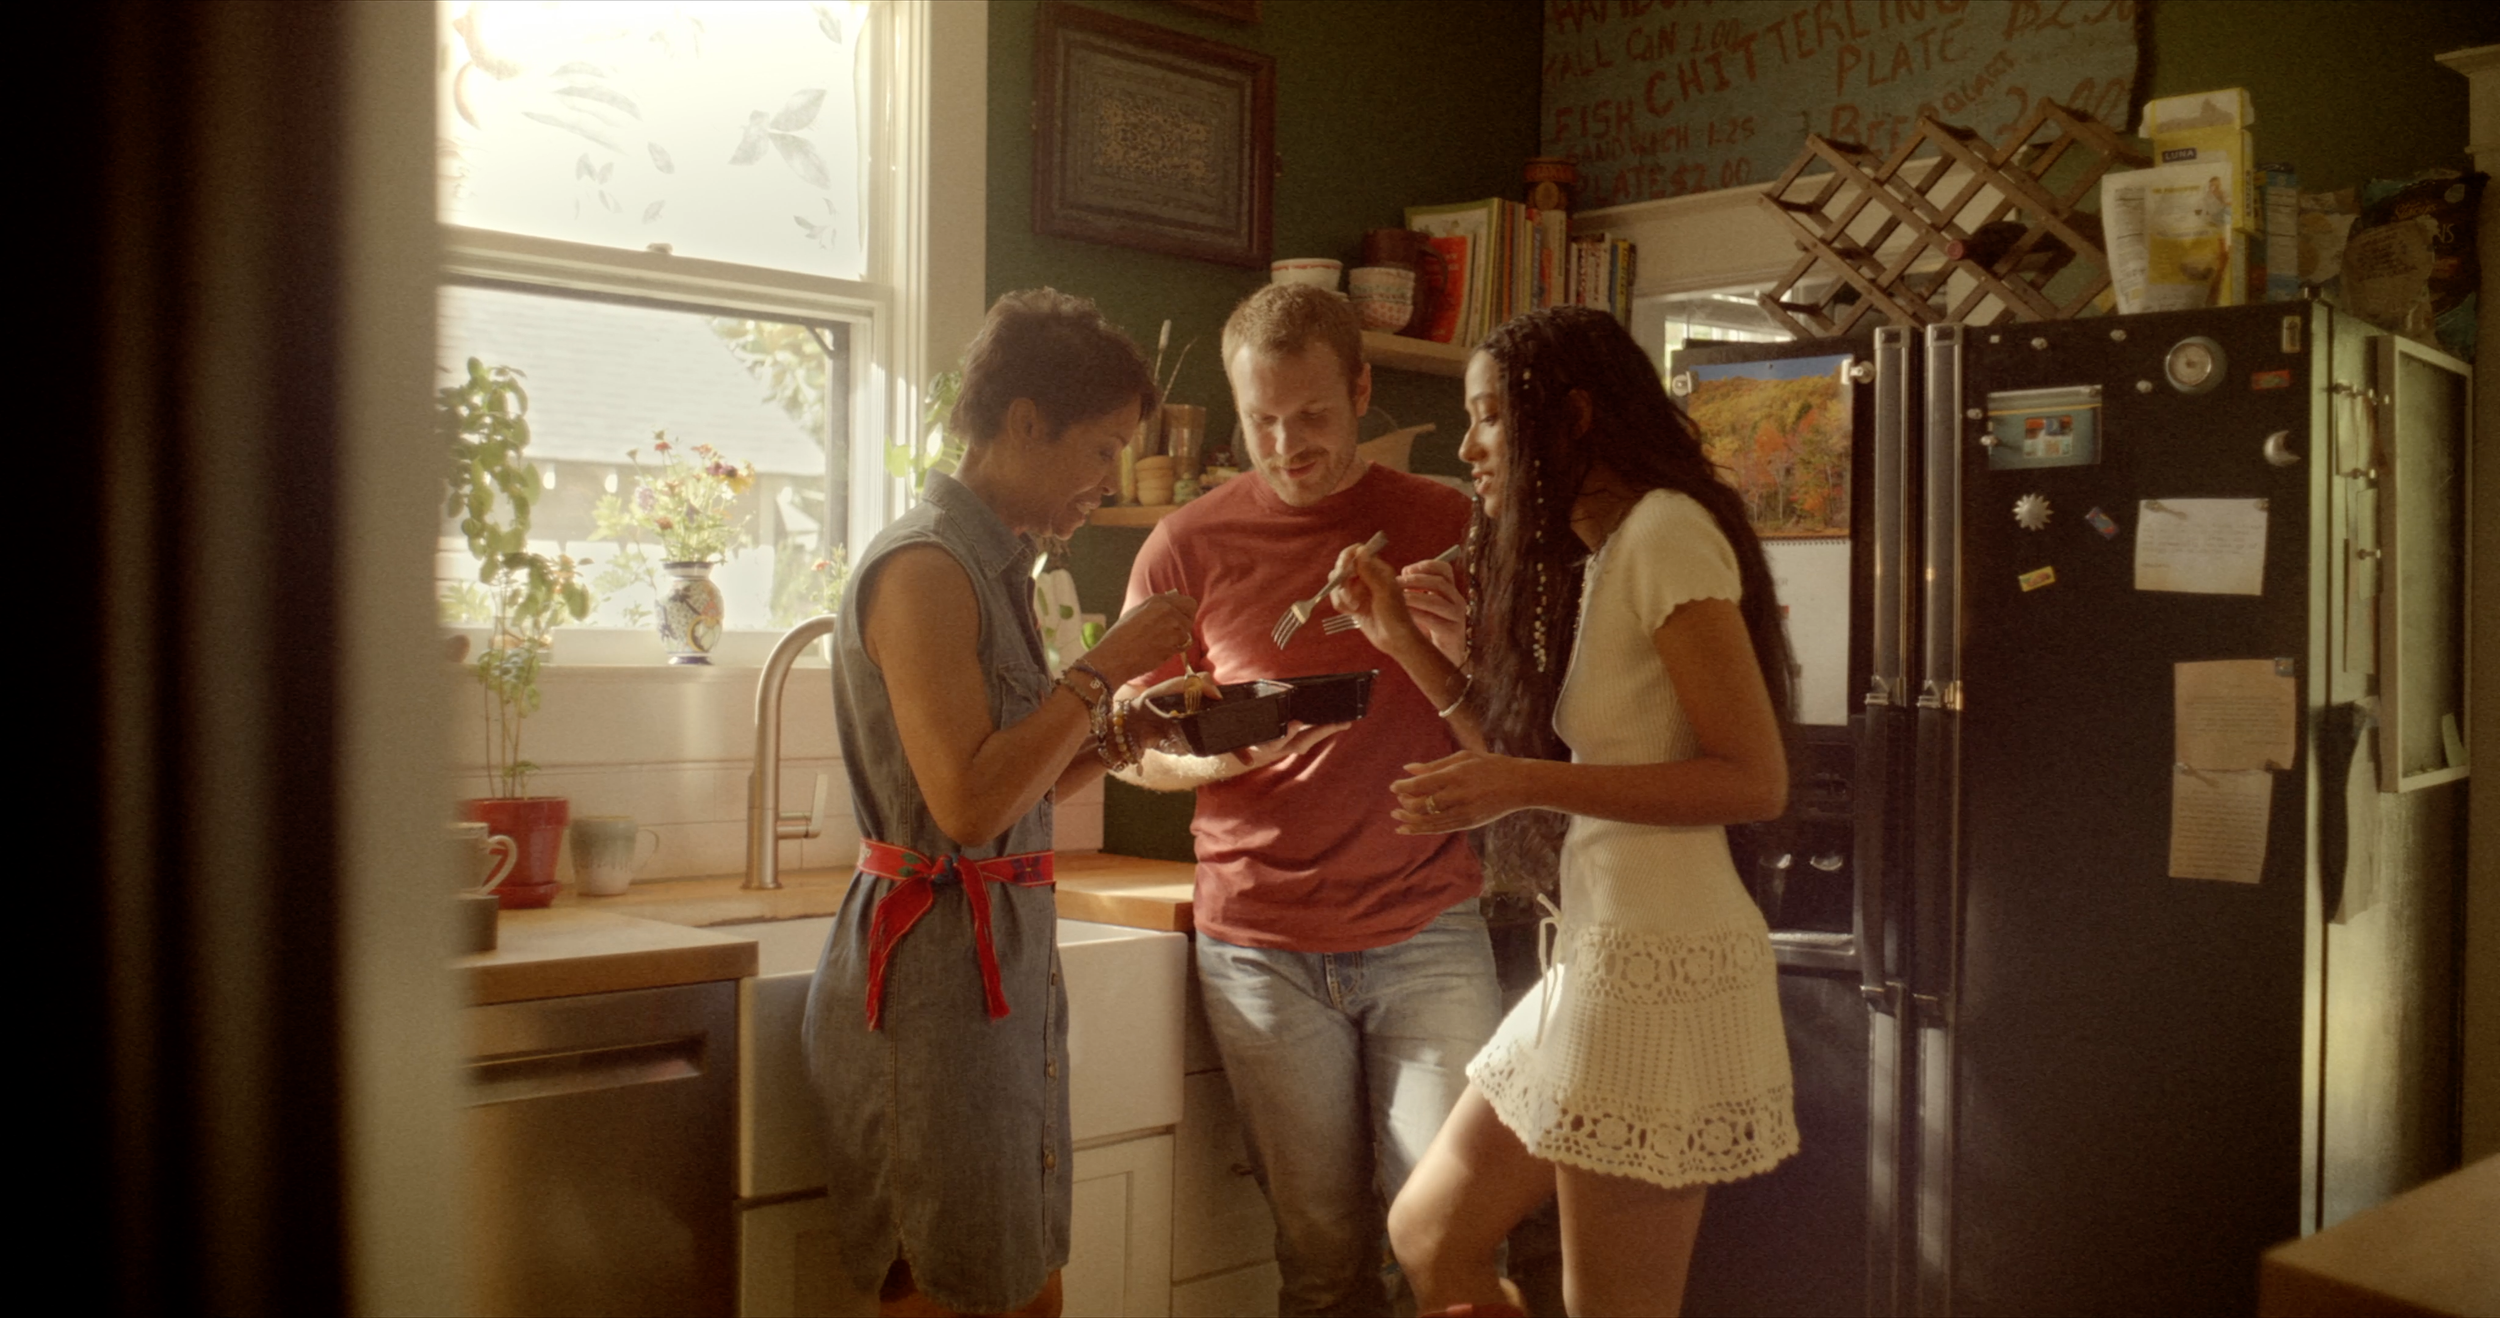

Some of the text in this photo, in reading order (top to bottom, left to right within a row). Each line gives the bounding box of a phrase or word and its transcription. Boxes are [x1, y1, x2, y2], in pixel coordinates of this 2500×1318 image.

[1836, 17, 1967, 98] PLATE
[1554, 95, 1637, 143] FISH
[1565, 125, 1690, 163] SANDWICH
[2164, 149, 2195, 161] LUNA
